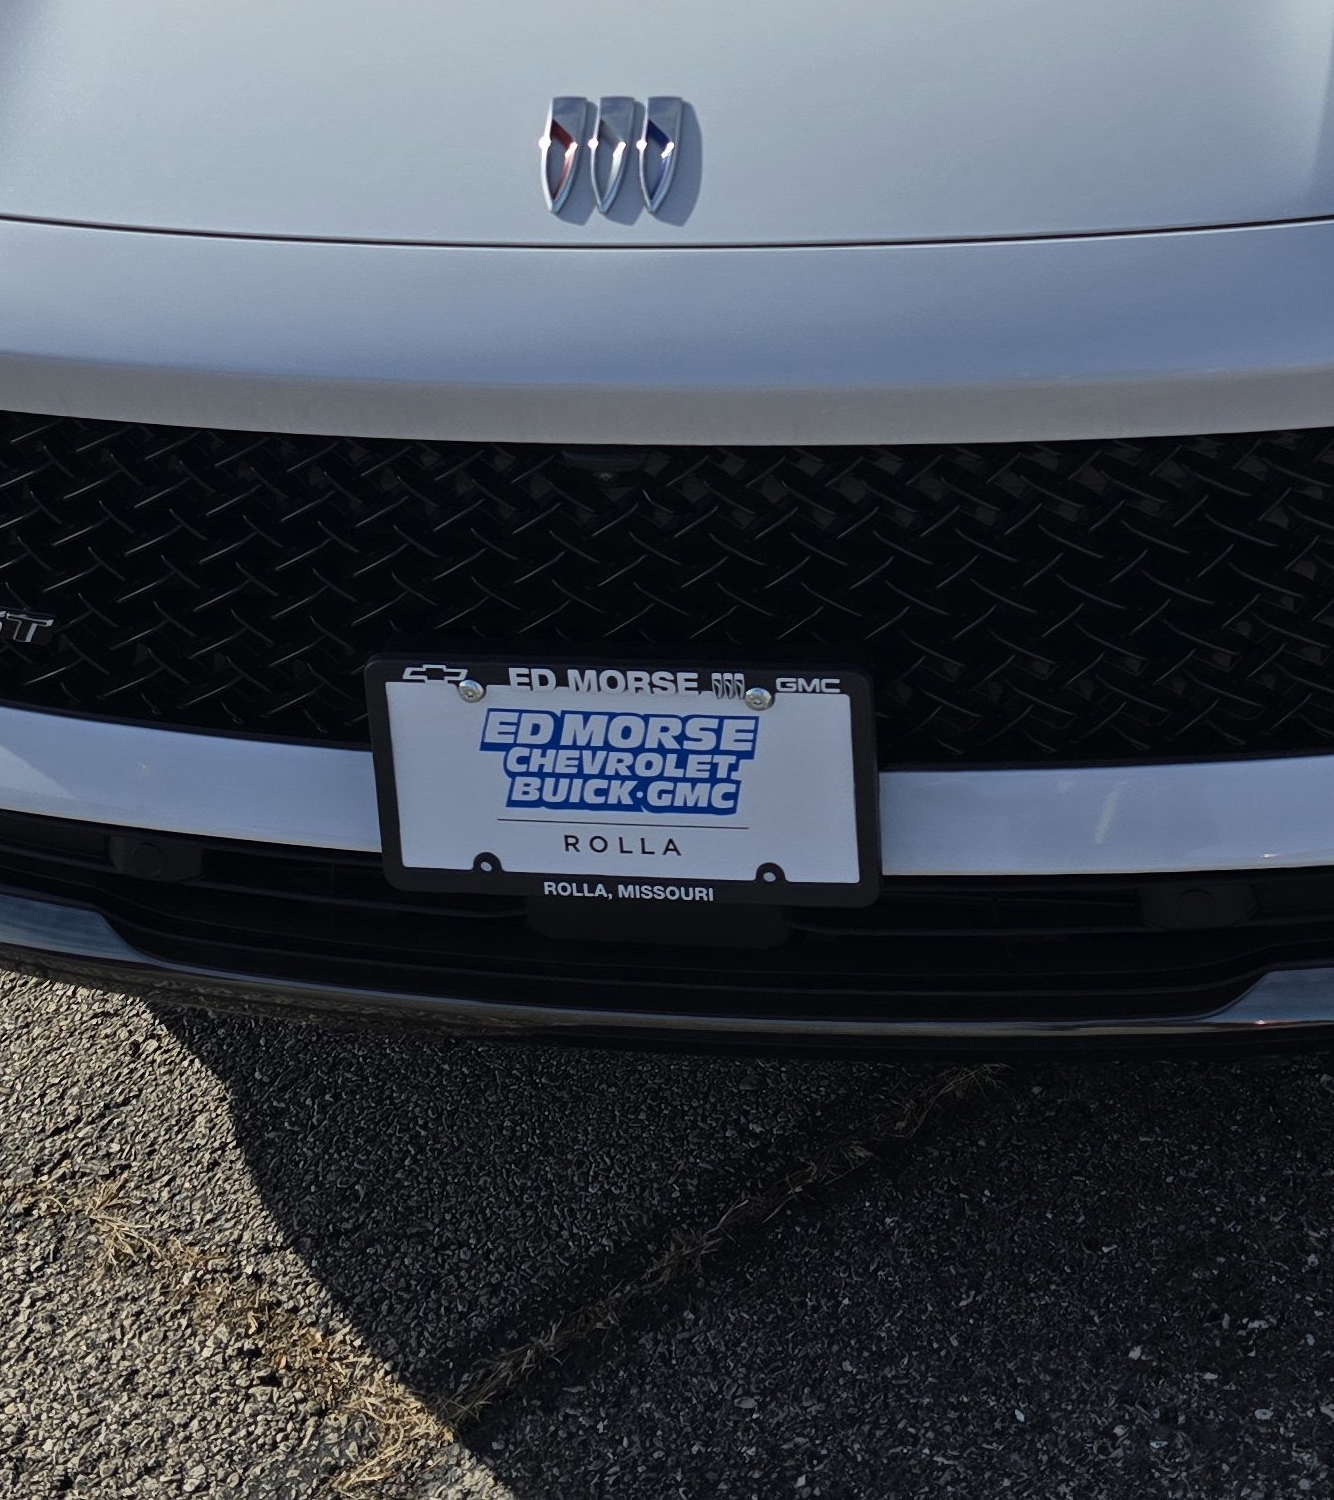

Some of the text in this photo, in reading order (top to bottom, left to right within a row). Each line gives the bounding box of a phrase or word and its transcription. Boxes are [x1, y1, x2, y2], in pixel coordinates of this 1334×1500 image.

[508, 667, 841, 695] ED MORSE GMC
[482, 710, 757, 752] ED MORSE
[505, 747, 738, 780] CHEVROLET
[563, 834, 682, 857] ROLLA
[543, 881, 714, 902] ROLLA, MISSOURI
